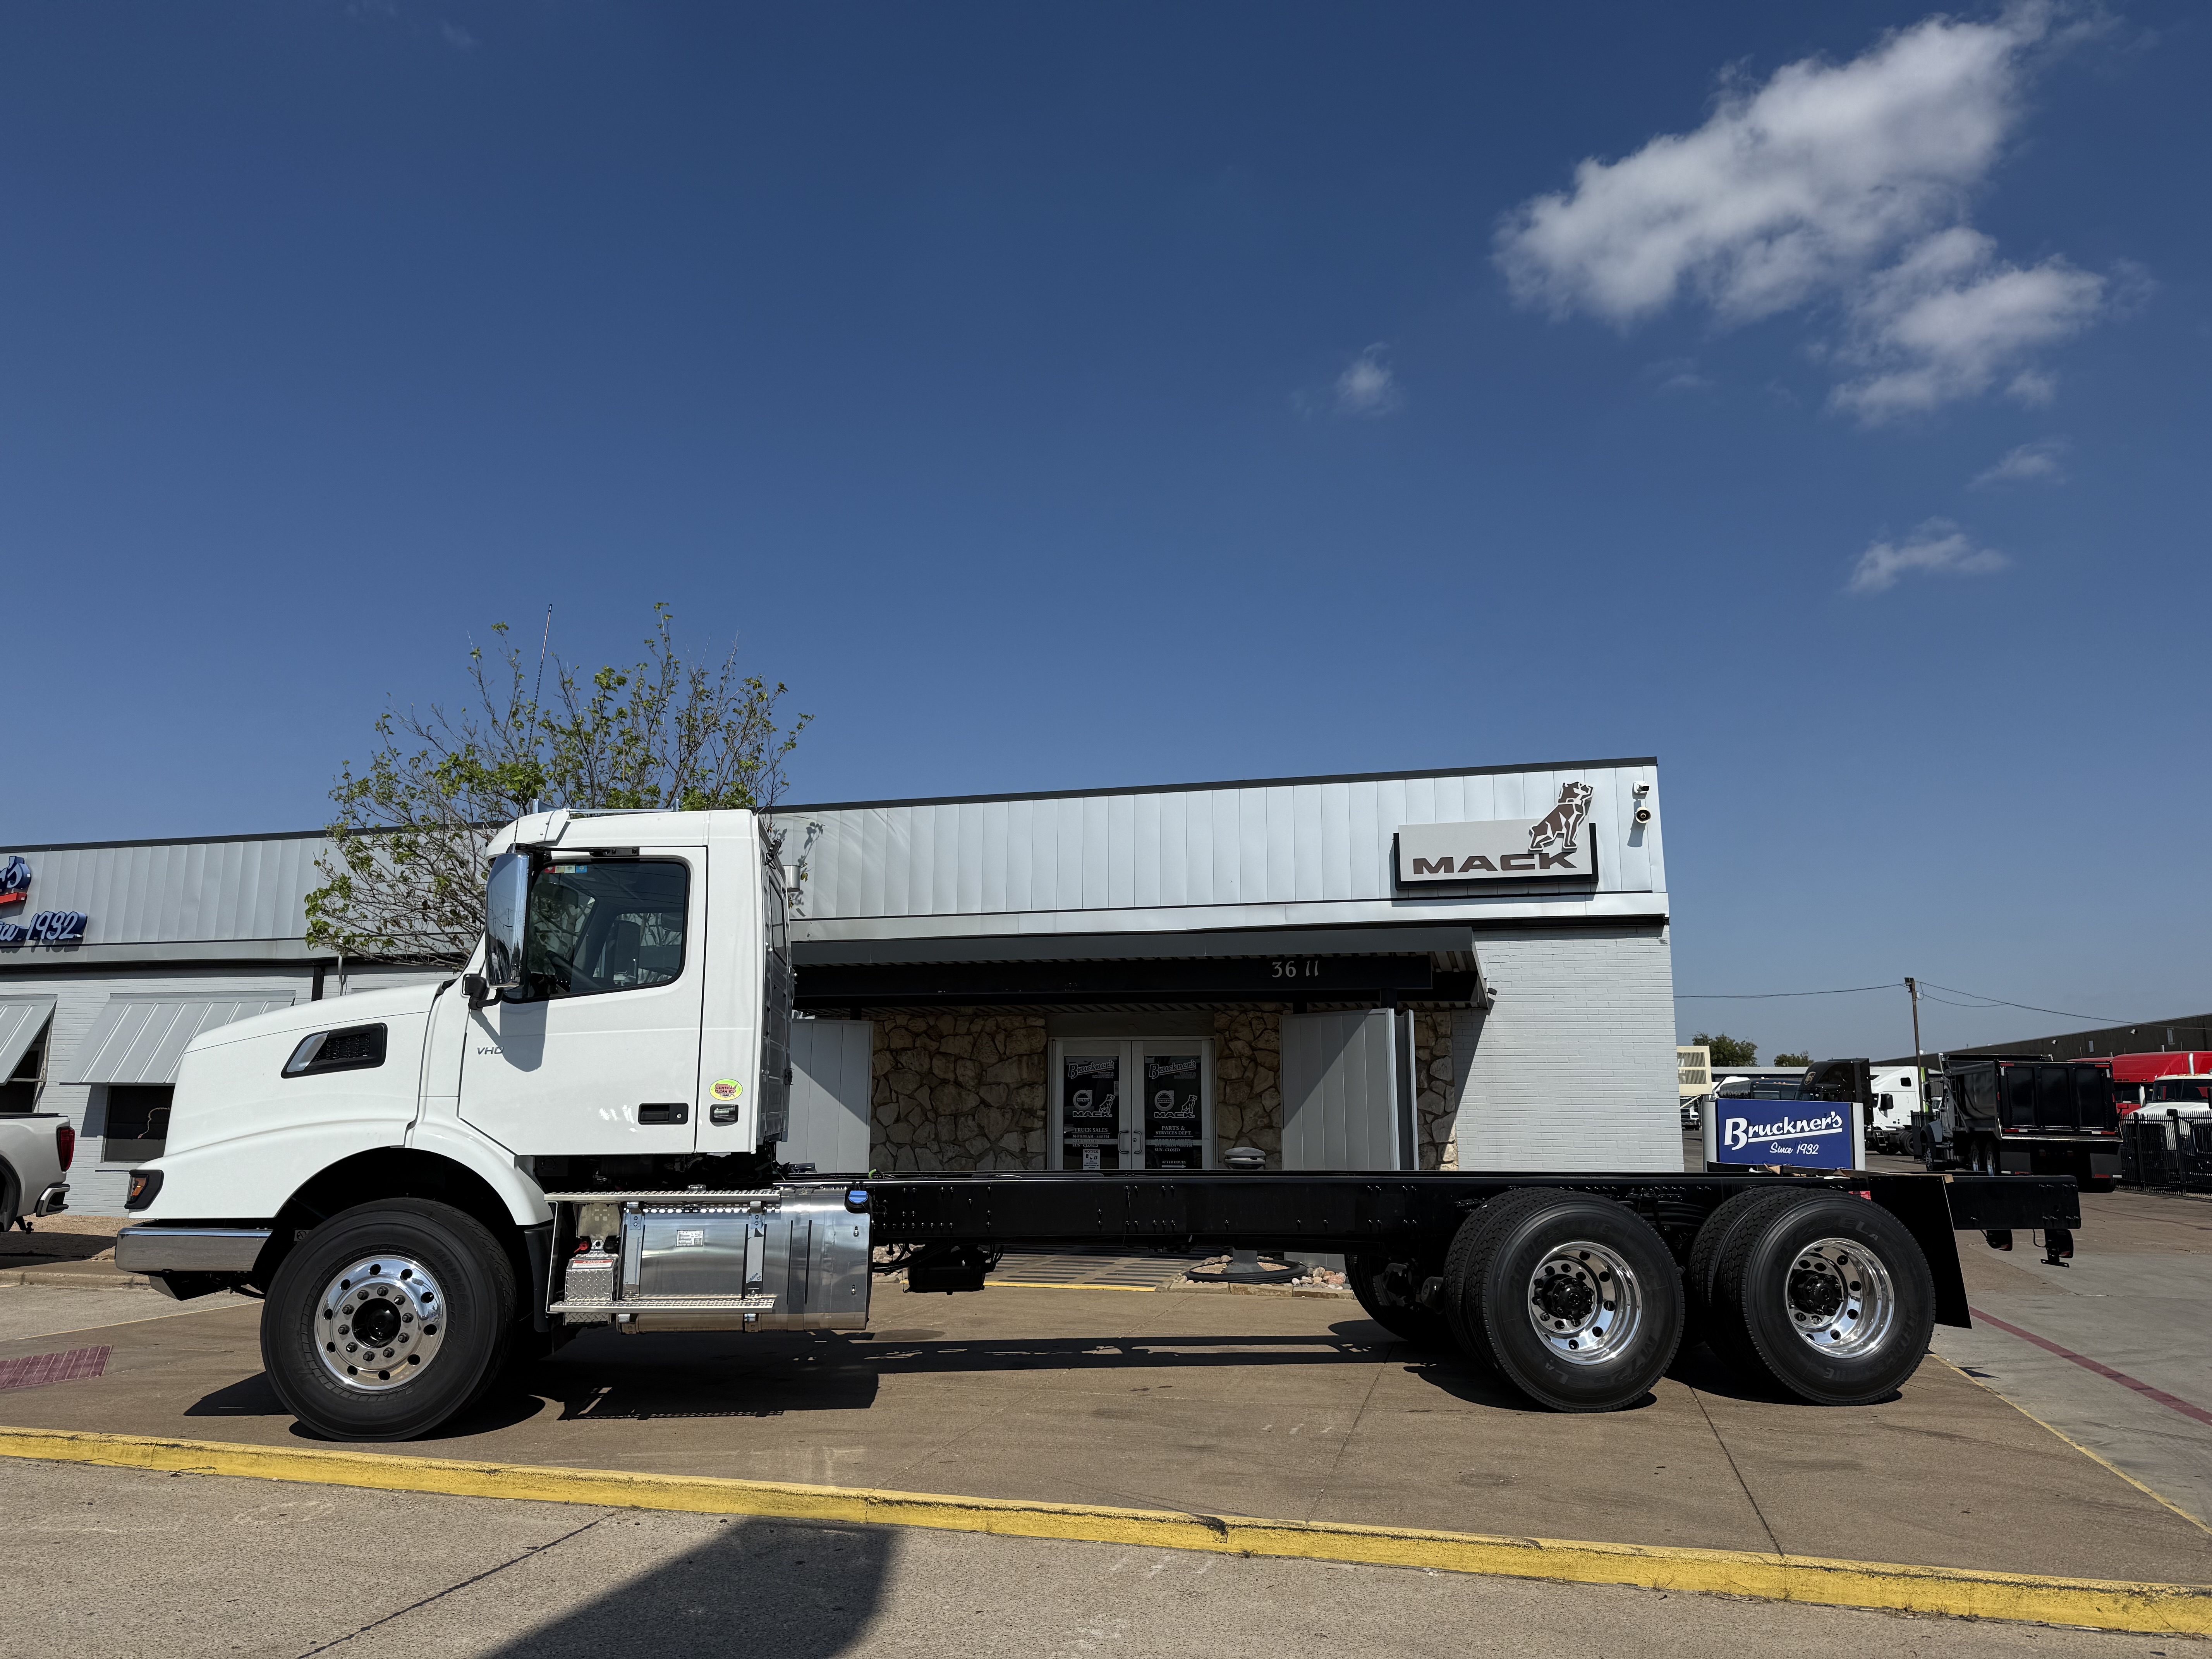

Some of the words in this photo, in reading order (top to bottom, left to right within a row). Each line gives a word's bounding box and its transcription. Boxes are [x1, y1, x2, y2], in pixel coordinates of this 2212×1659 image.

[1413, 852, 1577, 874] MACK
[26, 910, 84, 940] 1932
[477, 1046, 504, 1055] VHD
[1068, 1059, 1115, 1079] Bruckner's
[1149, 1059, 1197, 1079] Bruckner's
[1724, 1111, 1843, 1151] Bruckner's
[1769, 1142, 1794, 1154] Since
[1796, 1142, 1819, 1155] 1932
[1823, 1306, 1918, 1381] BRIDGESTNE
